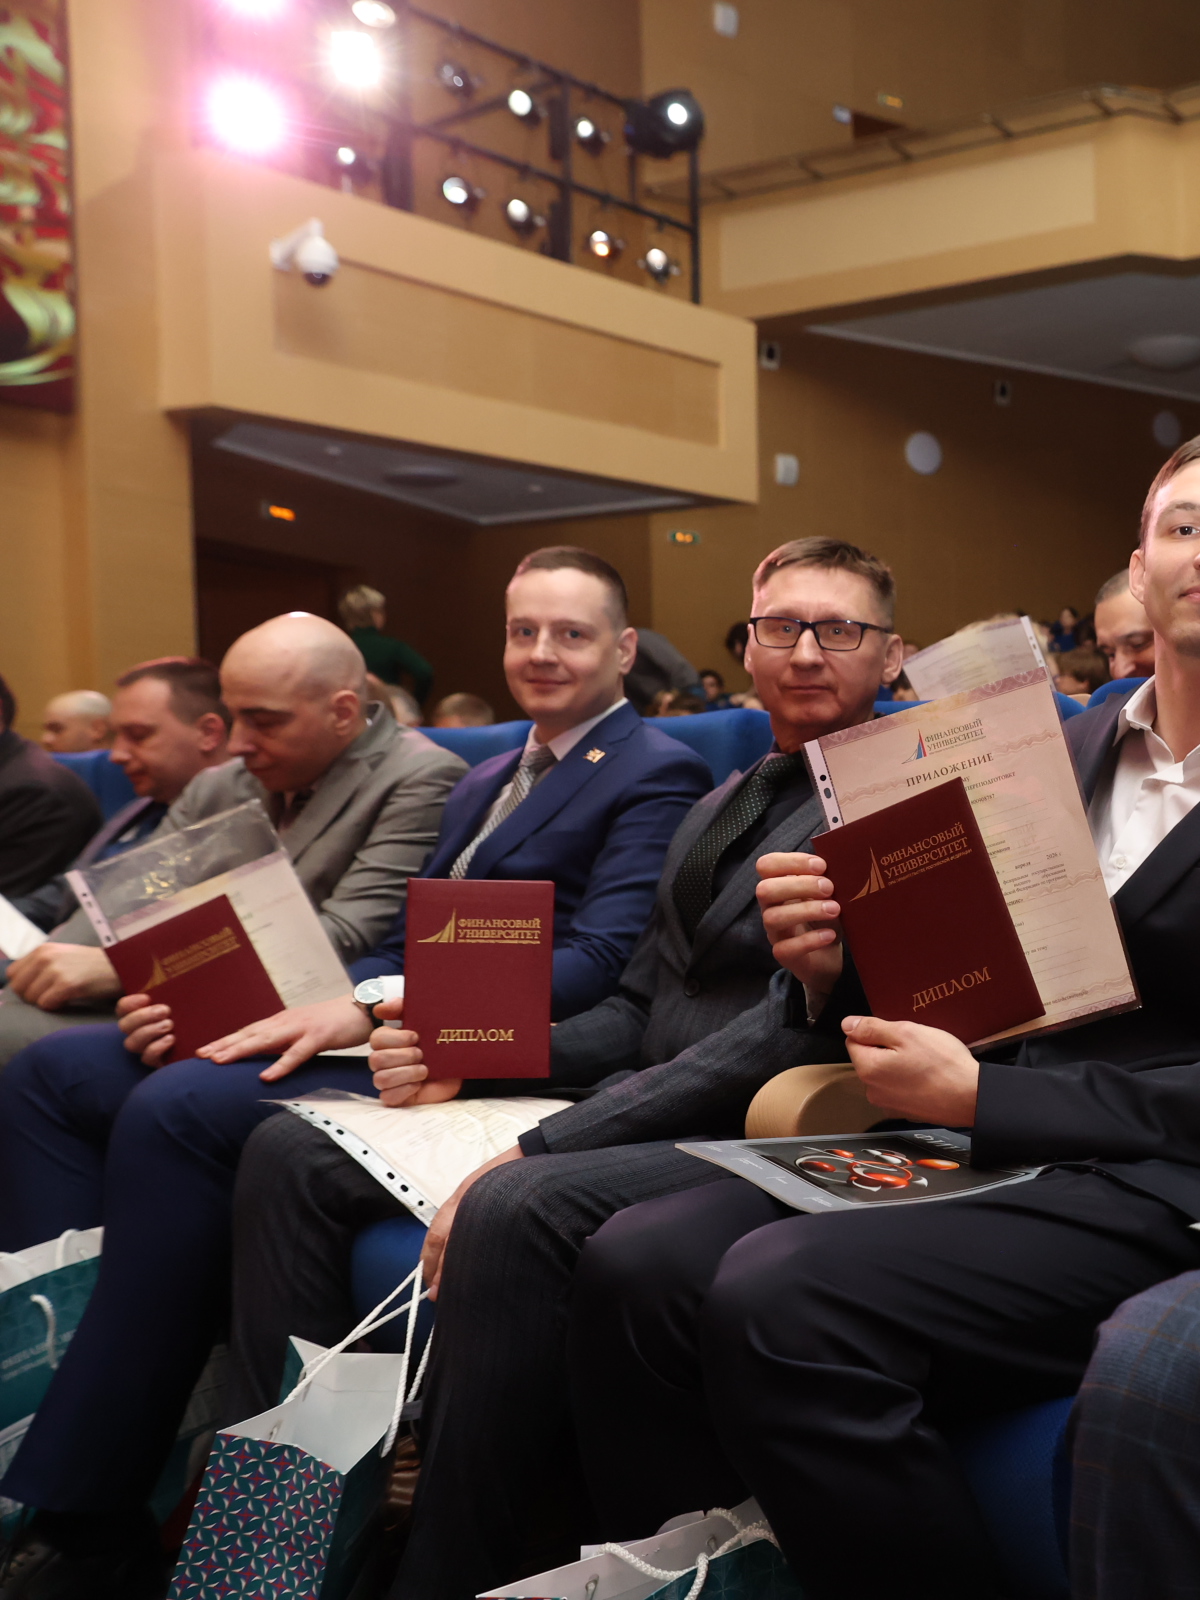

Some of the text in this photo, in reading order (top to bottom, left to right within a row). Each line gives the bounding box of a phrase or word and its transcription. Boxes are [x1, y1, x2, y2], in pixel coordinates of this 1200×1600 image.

[924, 718, 983, 743] ФИНАНСОВЫЙ
[926, 728, 985, 752] УНИВЕРСИТЕТ
[905, 752, 994, 788] ПРИЛОЖЕНИЕ
[880, 821, 965, 866] ФИНАНСОВЫЙ
[884, 836, 968, 879] УНИВЕРСИТЕТ
[457, 917, 542, 928] ФИНАНСОВЫЙ
[457, 929, 541, 939] УНИВЕРСИТЕТ
[912, 966, 992, 1012] ДИПЛОМ
[436, 1028, 514, 1044] ДИПЛОМ
